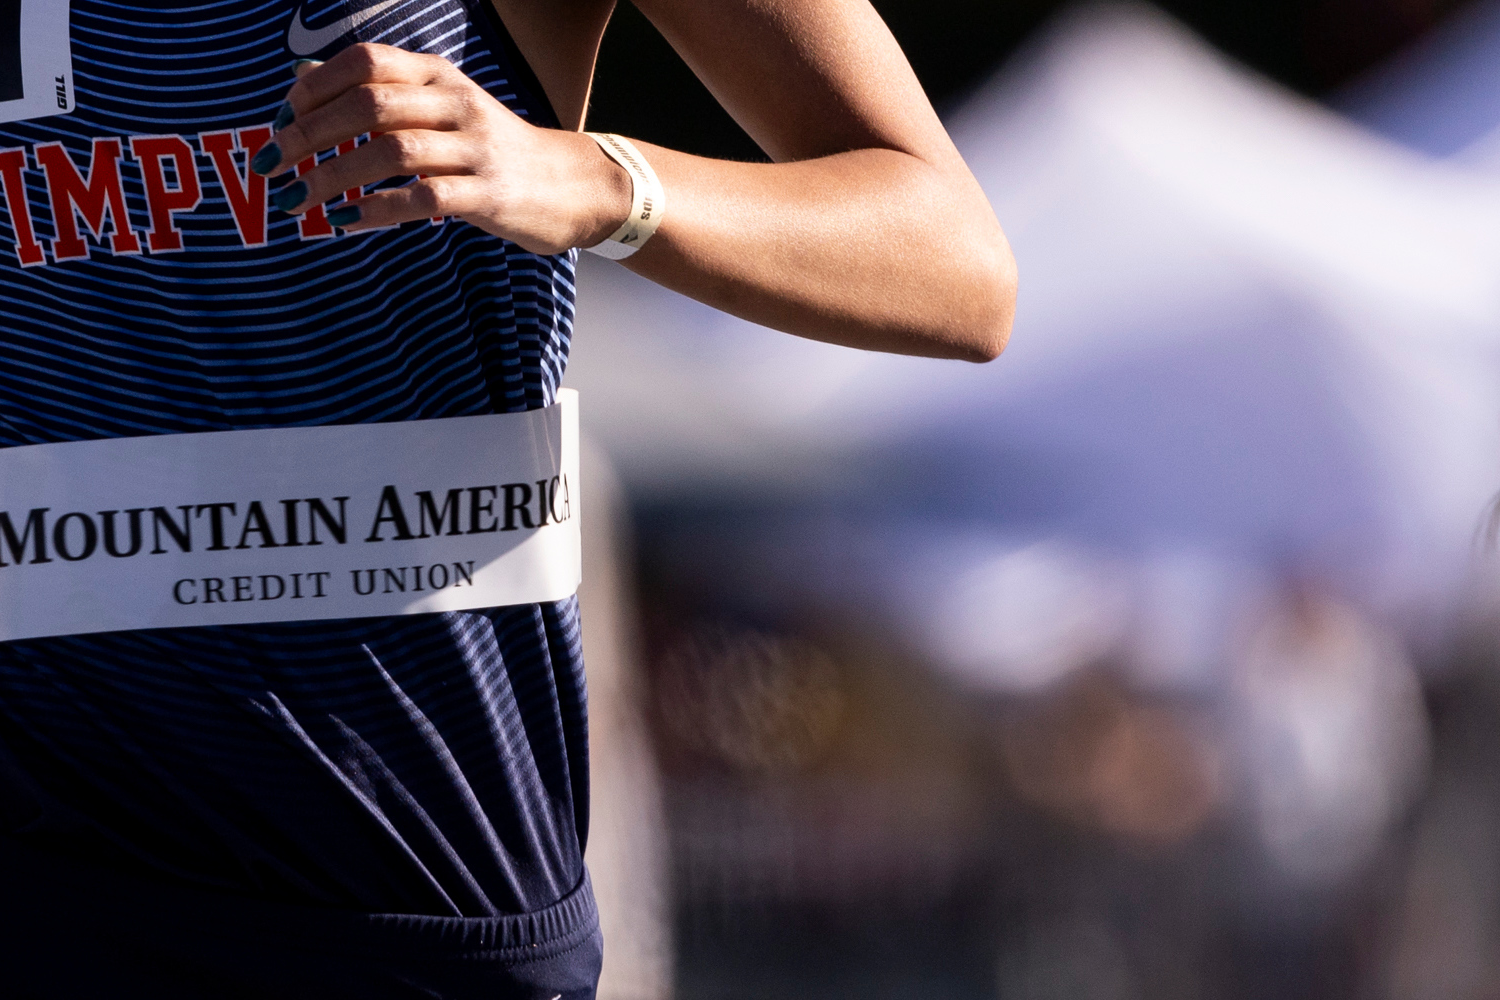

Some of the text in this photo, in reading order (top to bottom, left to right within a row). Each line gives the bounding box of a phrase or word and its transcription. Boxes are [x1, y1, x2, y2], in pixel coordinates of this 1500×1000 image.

[54, 74, 68, 110] GILL
[365, 472, 571, 544] AMERICA
[172, 560, 477, 605] CREDIT UNION
